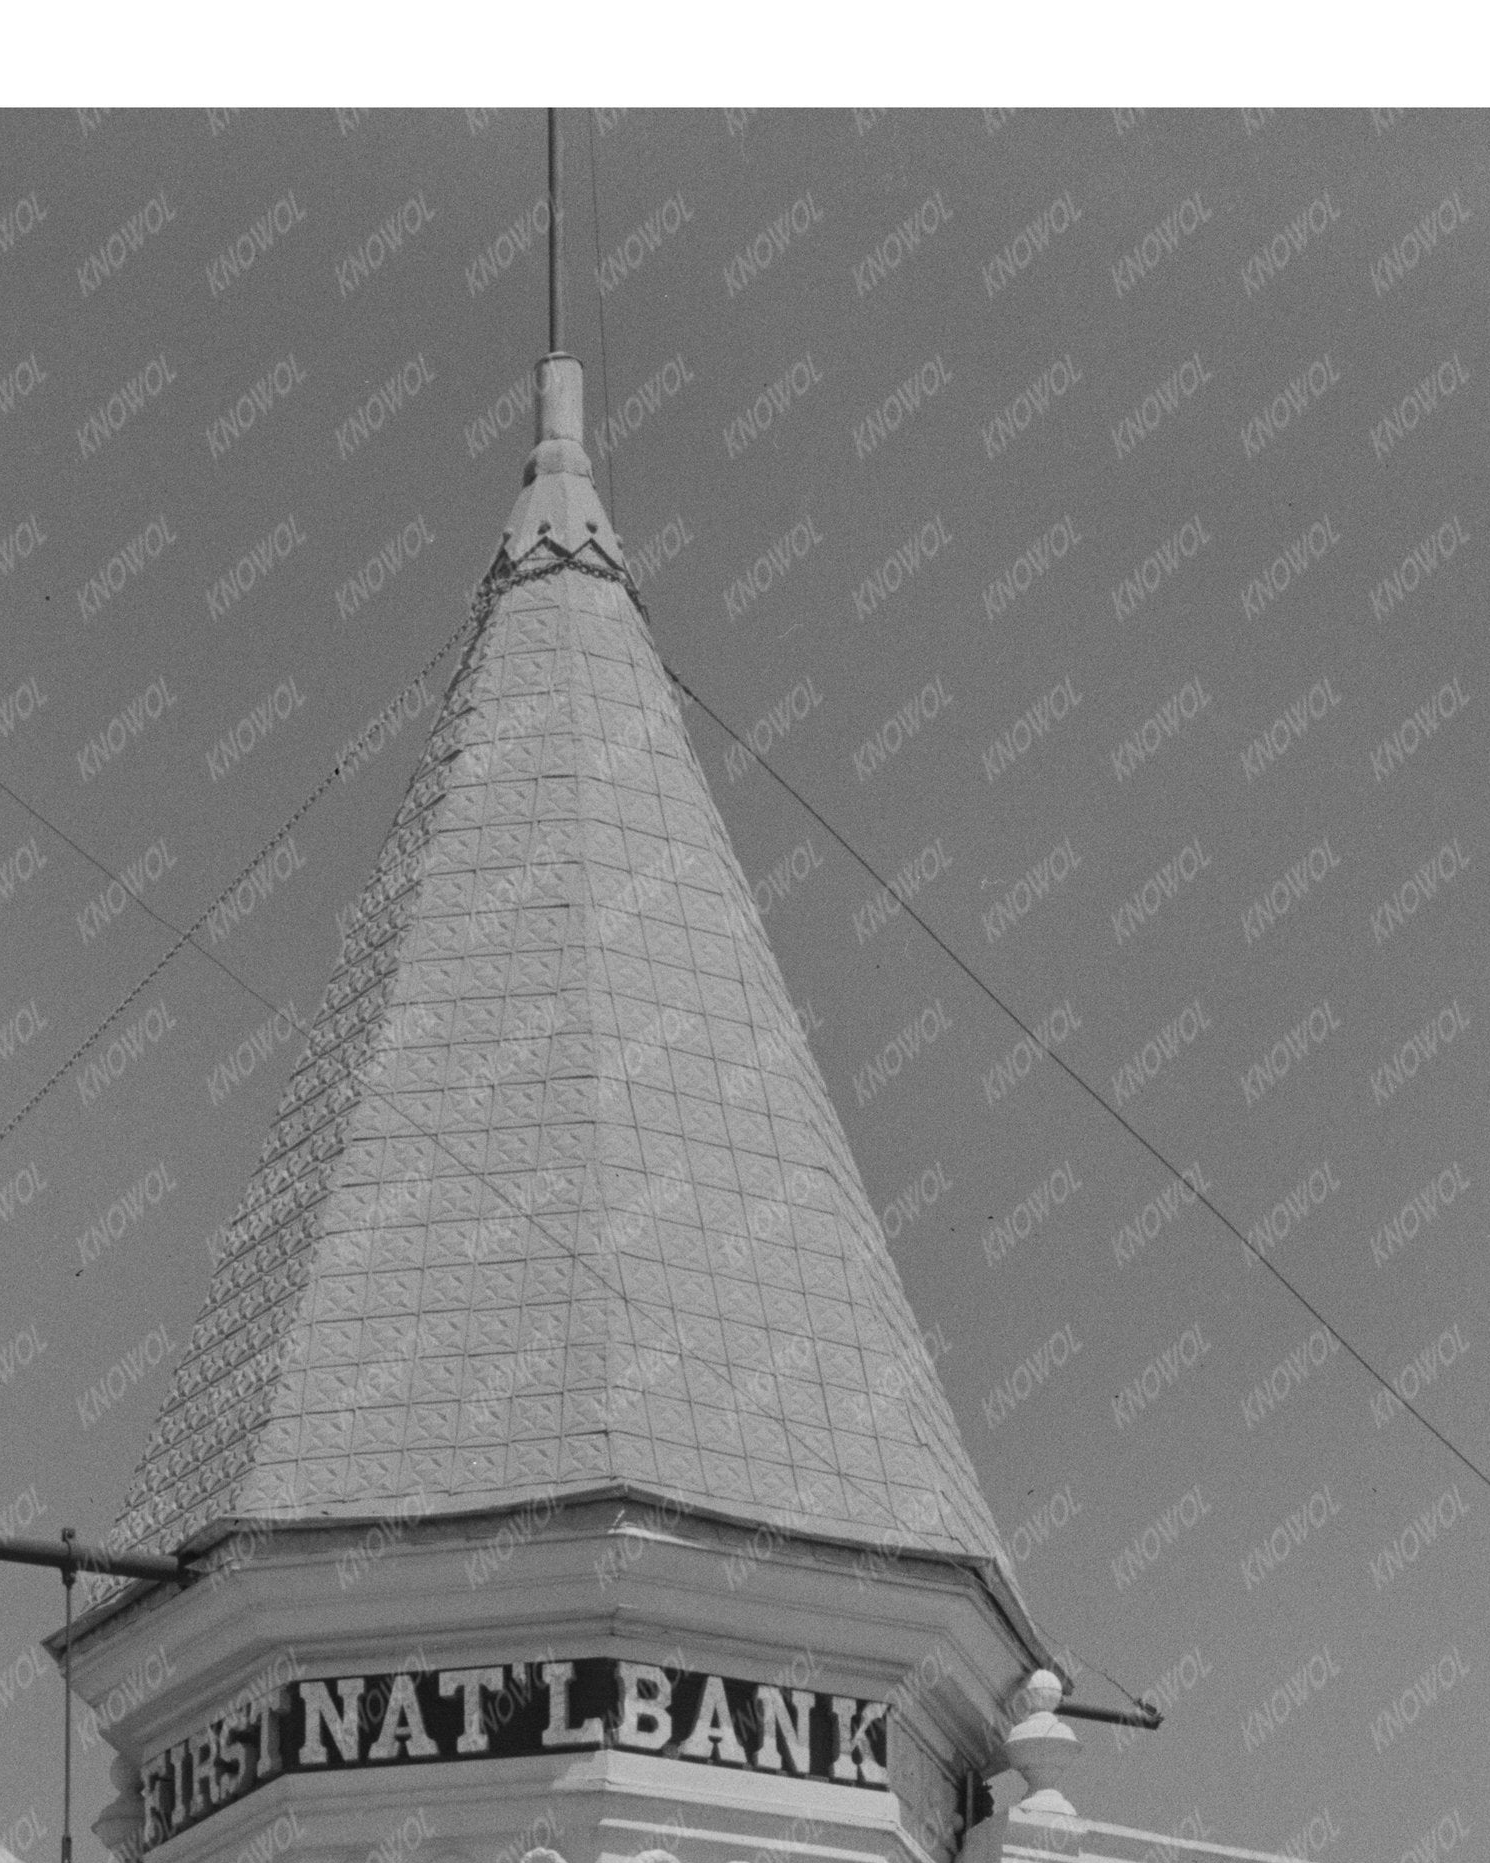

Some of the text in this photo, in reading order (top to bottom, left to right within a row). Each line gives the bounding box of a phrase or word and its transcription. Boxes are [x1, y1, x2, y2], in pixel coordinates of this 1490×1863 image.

[141, 1661, 893, 1841] FIRST NAT'L BANK
